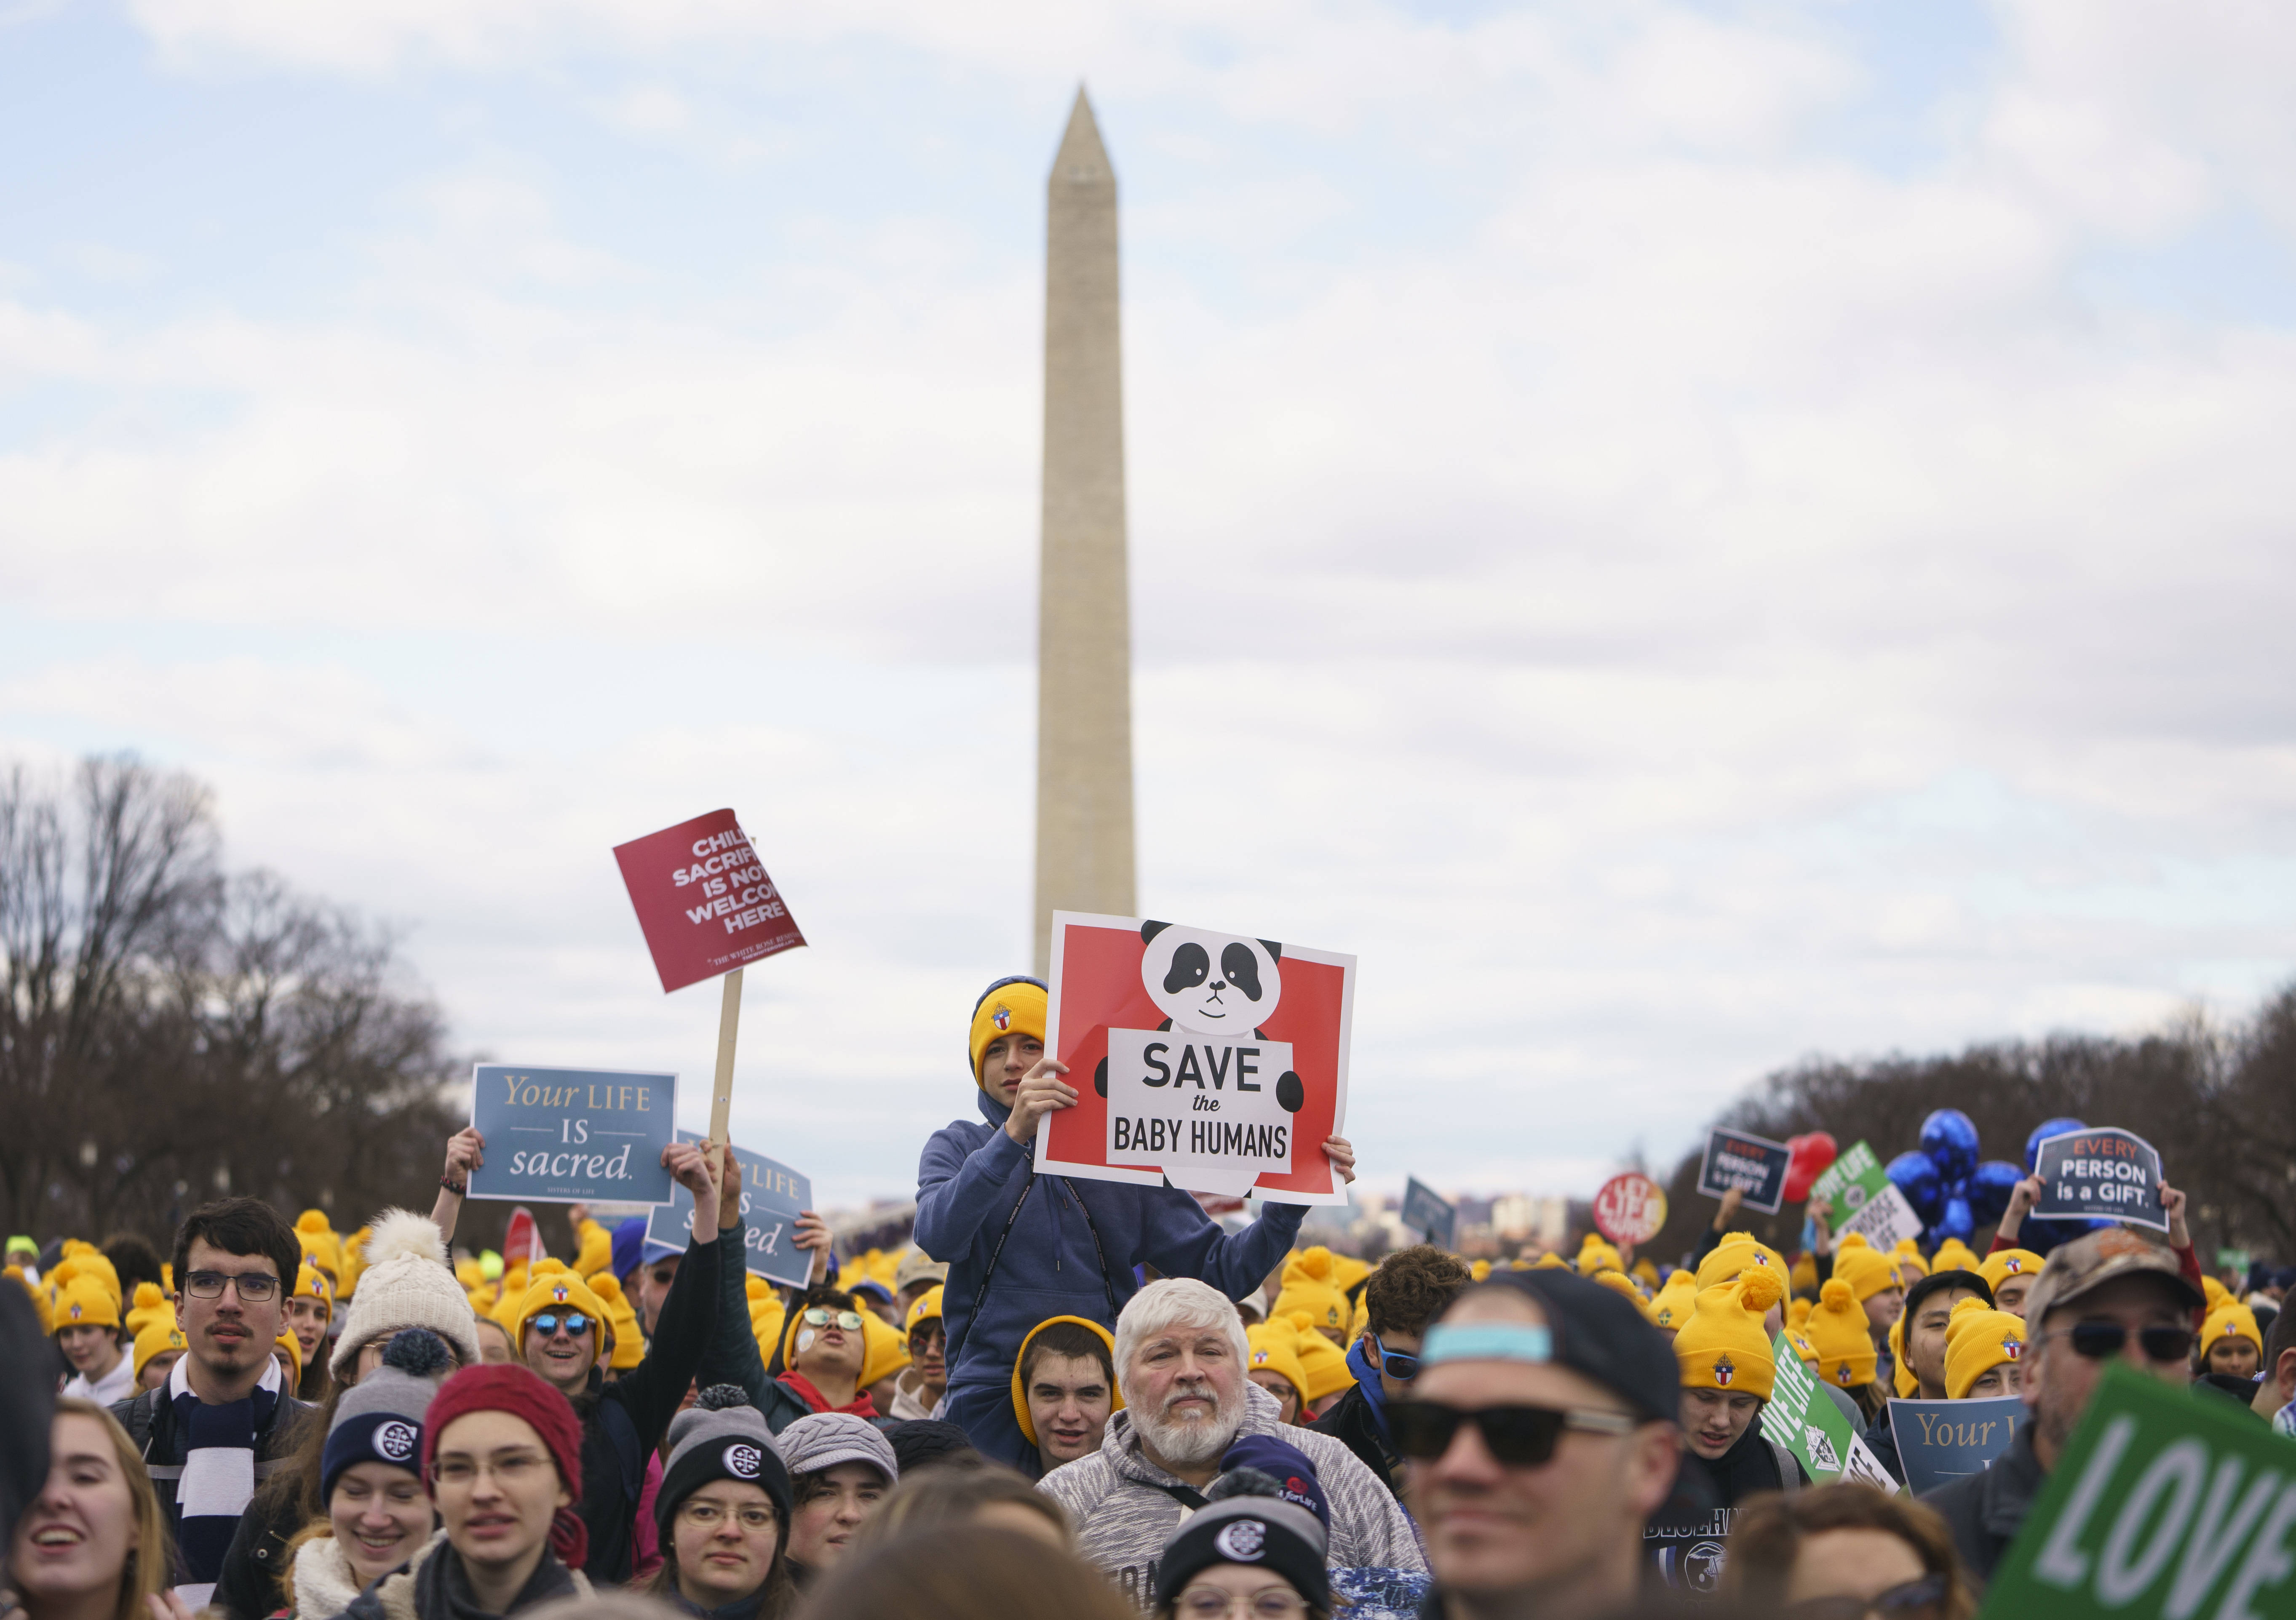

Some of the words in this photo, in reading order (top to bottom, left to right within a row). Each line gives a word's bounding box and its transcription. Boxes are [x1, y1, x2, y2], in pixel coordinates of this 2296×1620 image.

[703, 877, 727, 899] IS
[729, 865, 768, 889] NOT
[724, 901, 785, 934] HERE
[714, 955, 730, 966] THE
[730, 945, 756, 960] WHITE
[756, 939, 775, 952] ROSE
[1141, 1042, 1262, 1092] SAVE
[504, 1076, 580, 1108] Your
[587, 1084, 650, 1112] LIFE
[1192, 1094, 1221, 1112] the
[561, 1118, 588, 1145] IS
[1114, 1117, 1183, 1153] BABY
[1191, 1121, 1287, 1160] HUMANS
[2073, 1138, 2138, 1159] EVERY
[509, 1144, 633, 1180] sacred.
[2061, 1159, 2146, 1187] PERSON
[752, 1163, 799, 1200] LIFE
[2057, 1181, 2074, 1201] is
[2079, 1185, 2092, 1201] a
[2098, 1182, 2149, 1209] GIFT.
[1008, 1206, 1019, 1225] UNDER
[1018, 1185, 1030, 1206] ARMOUR
[1915, 1413, 1997, 1447] Your
